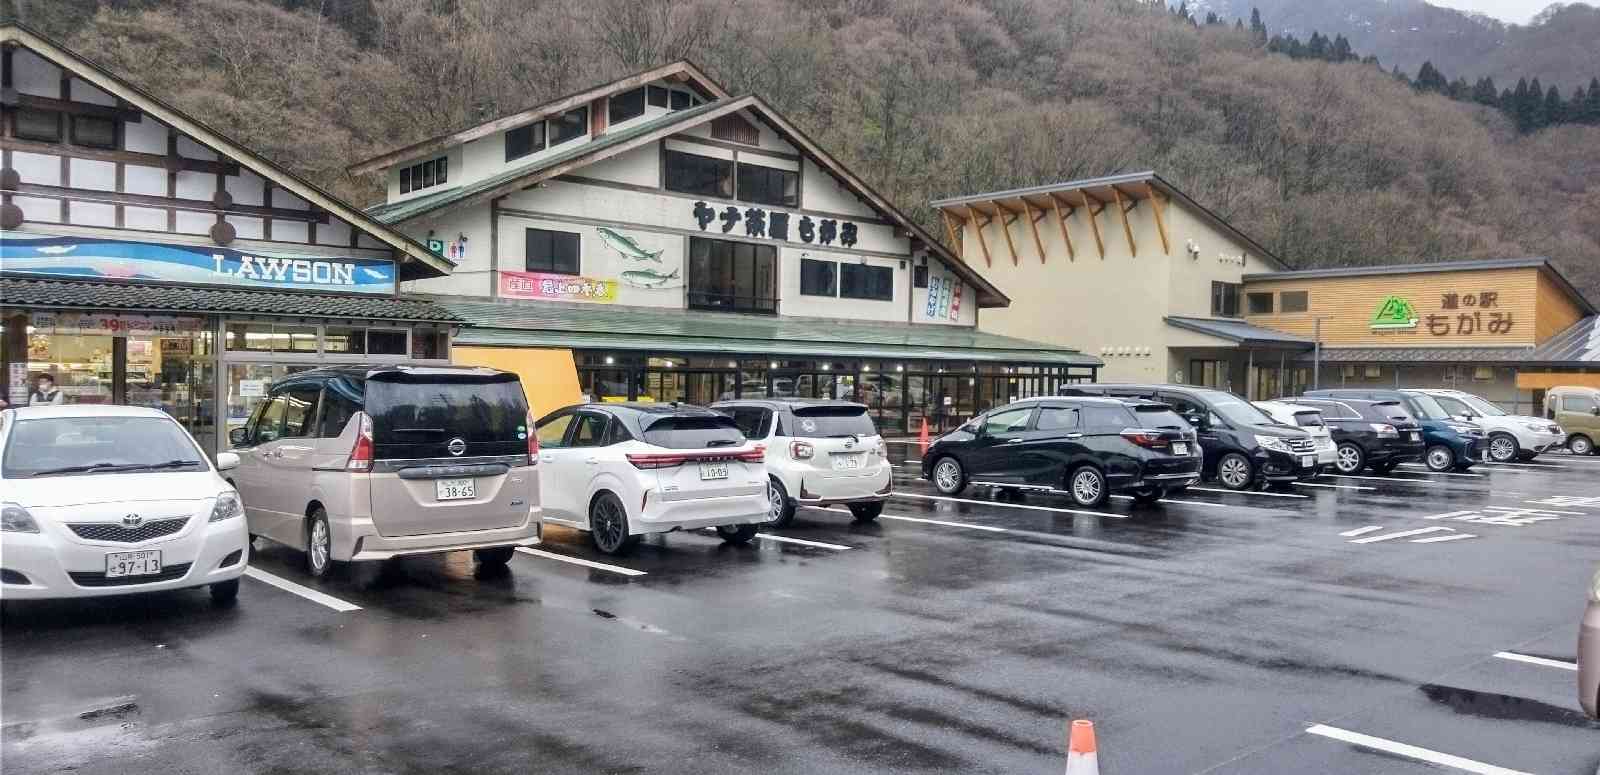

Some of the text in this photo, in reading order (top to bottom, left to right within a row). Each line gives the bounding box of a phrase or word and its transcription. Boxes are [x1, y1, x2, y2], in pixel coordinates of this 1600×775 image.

[798, 215, 858, 248] もがみ
[212, 254, 356, 285] LAWSON
[1441, 291, 1499, 310] 道の駅
[1425, 311, 1515, 337] もがみ
[445, 486, 474, 498] 38-65
[119, 559, 159, 575] 97-13
